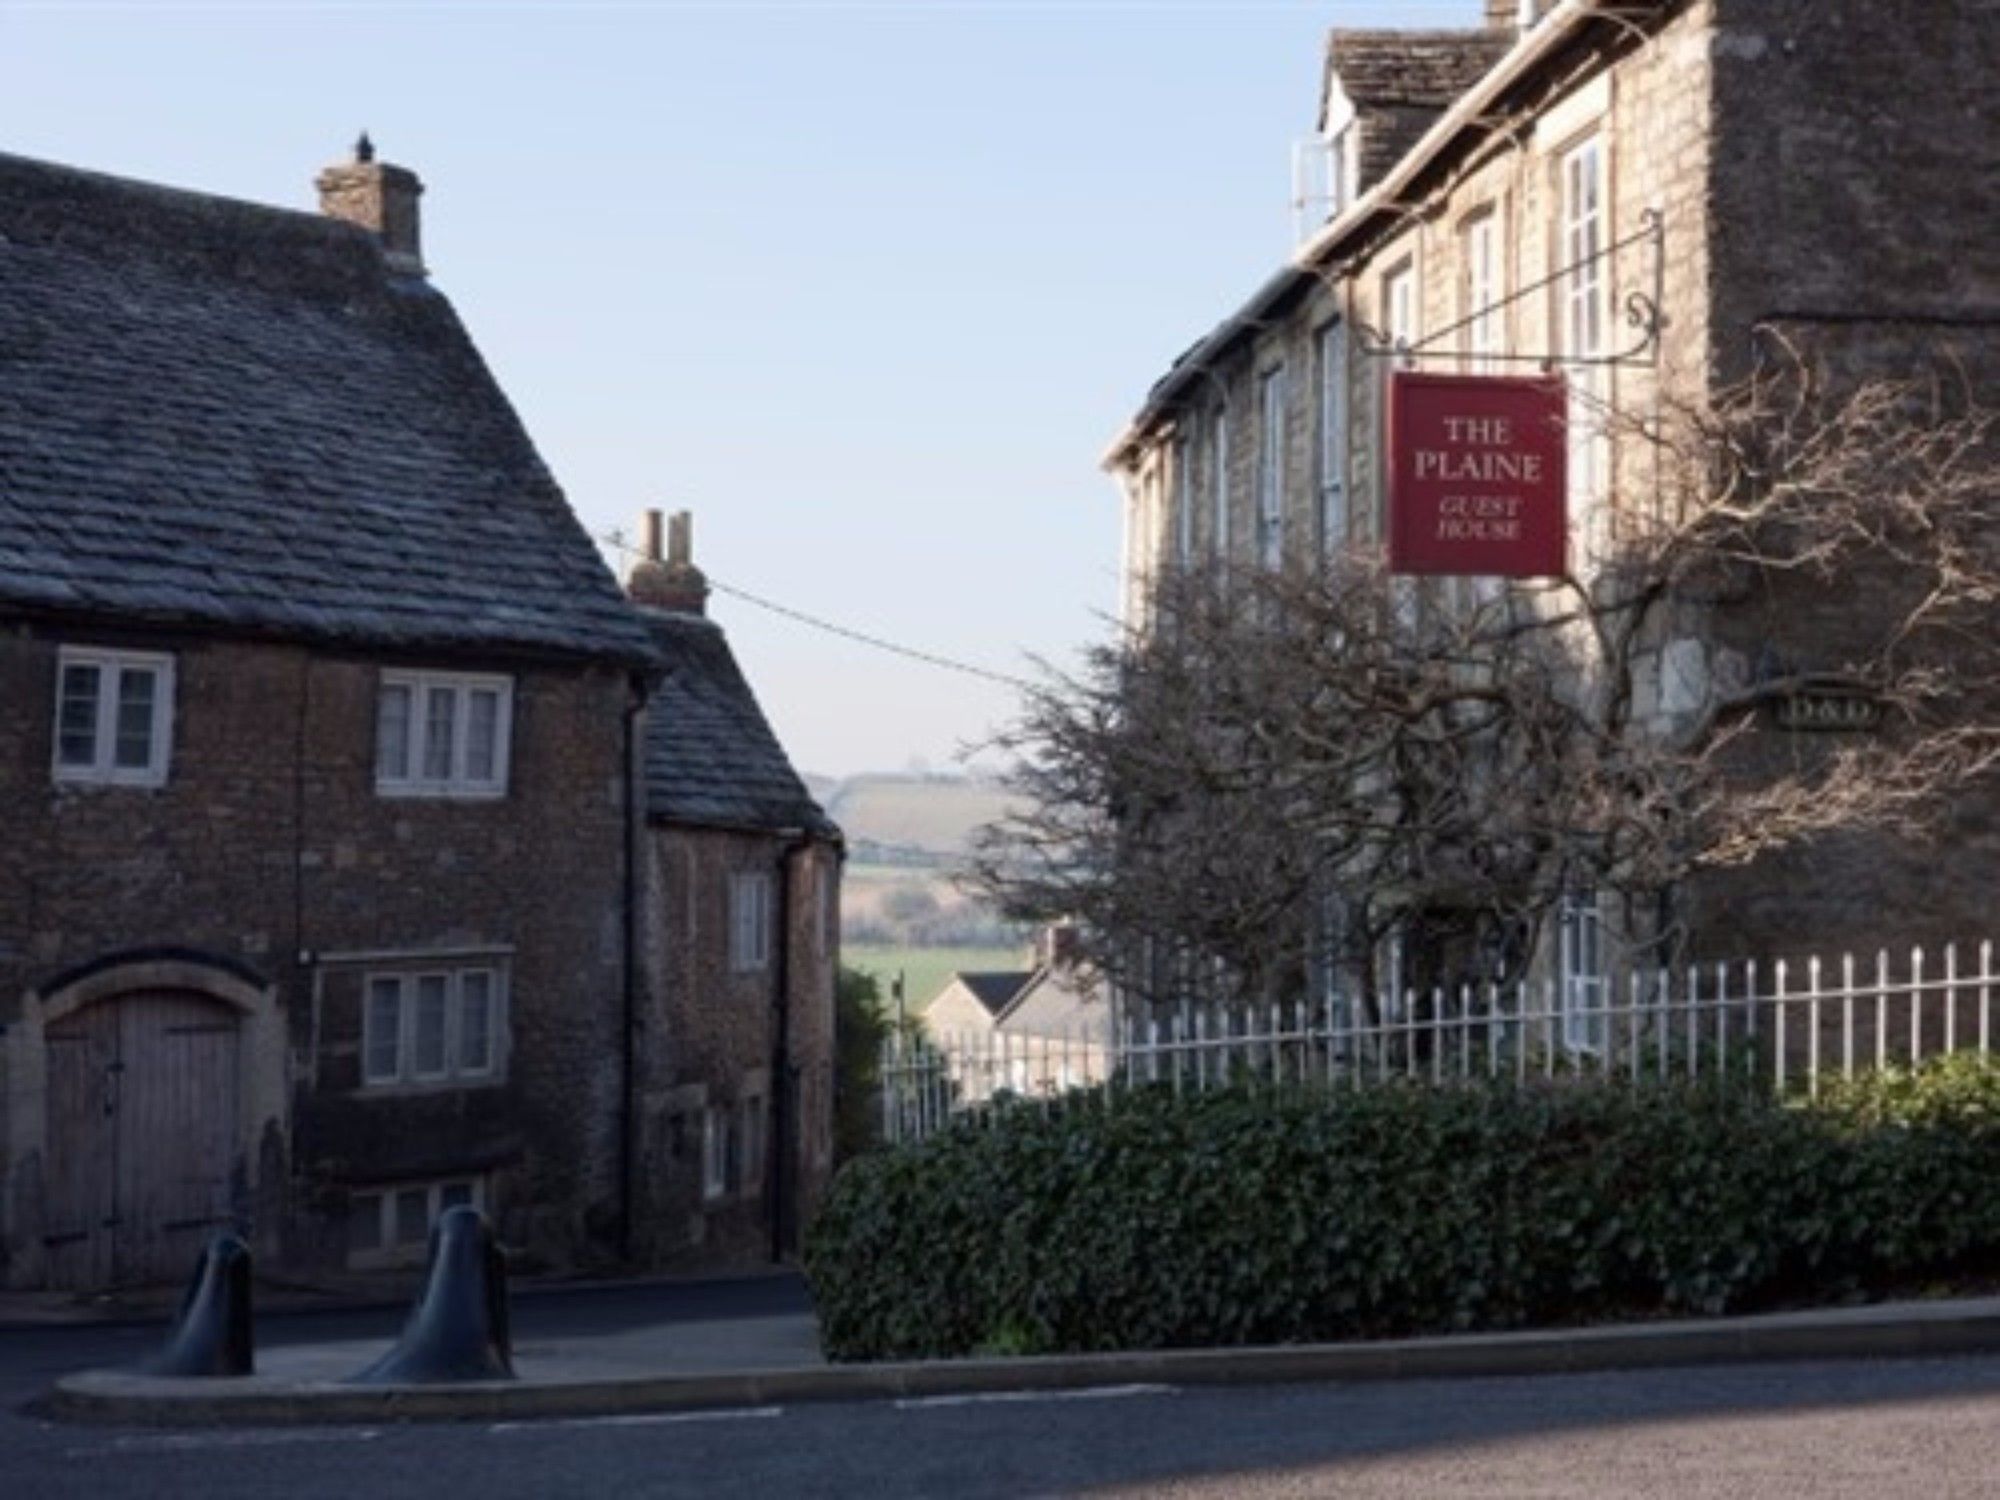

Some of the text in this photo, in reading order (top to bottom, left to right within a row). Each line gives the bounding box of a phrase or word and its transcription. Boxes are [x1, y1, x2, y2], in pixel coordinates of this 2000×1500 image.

[1443, 416, 1511, 445] THE
[1414, 450, 1542, 482] PLAINE
[1438, 496, 1523, 517] GUEST
[1436, 519, 1520, 541] HOUSE
